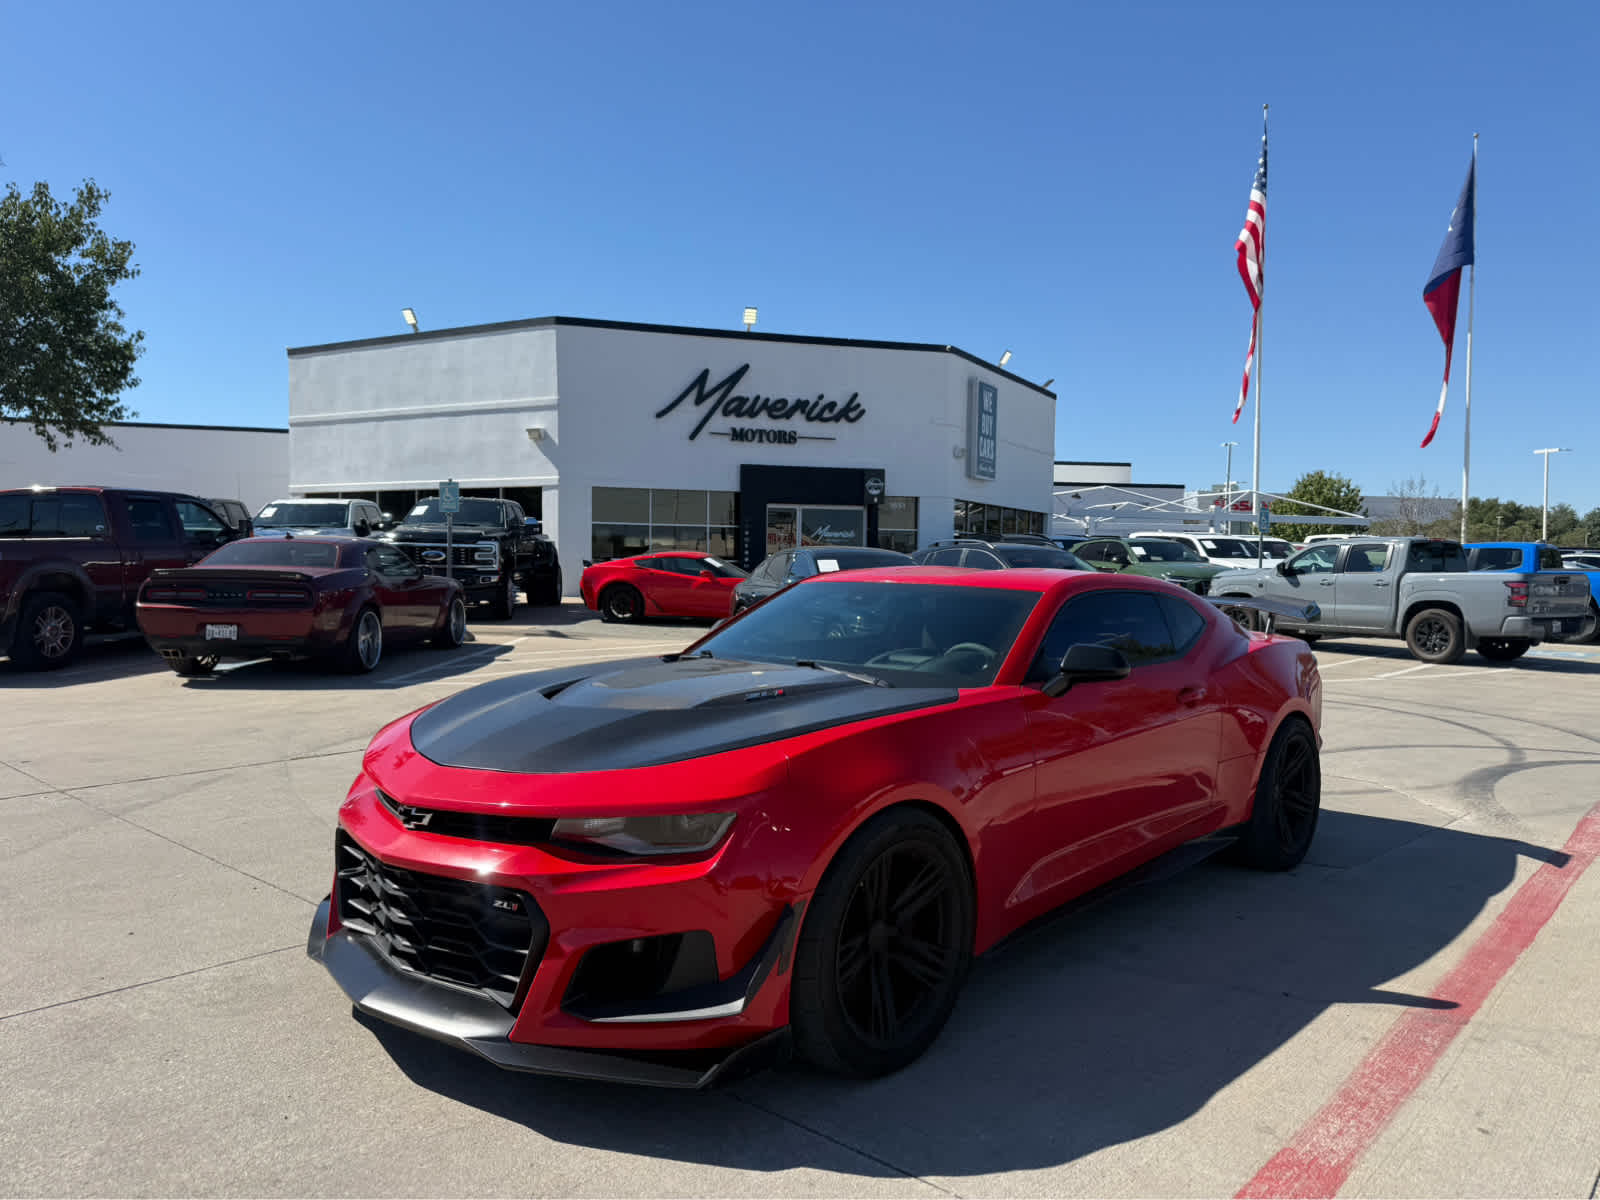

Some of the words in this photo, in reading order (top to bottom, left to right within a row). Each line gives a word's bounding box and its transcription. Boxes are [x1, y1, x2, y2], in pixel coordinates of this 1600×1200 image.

[656, 363, 866, 441] Maverick
[983, 391, 992, 413] WE
[730, 427, 798, 445] MOTORS
[982, 413, 993, 437] BUY
[979, 436, 994, 459] CARS
[493, 900, 518, 911] ZL1
